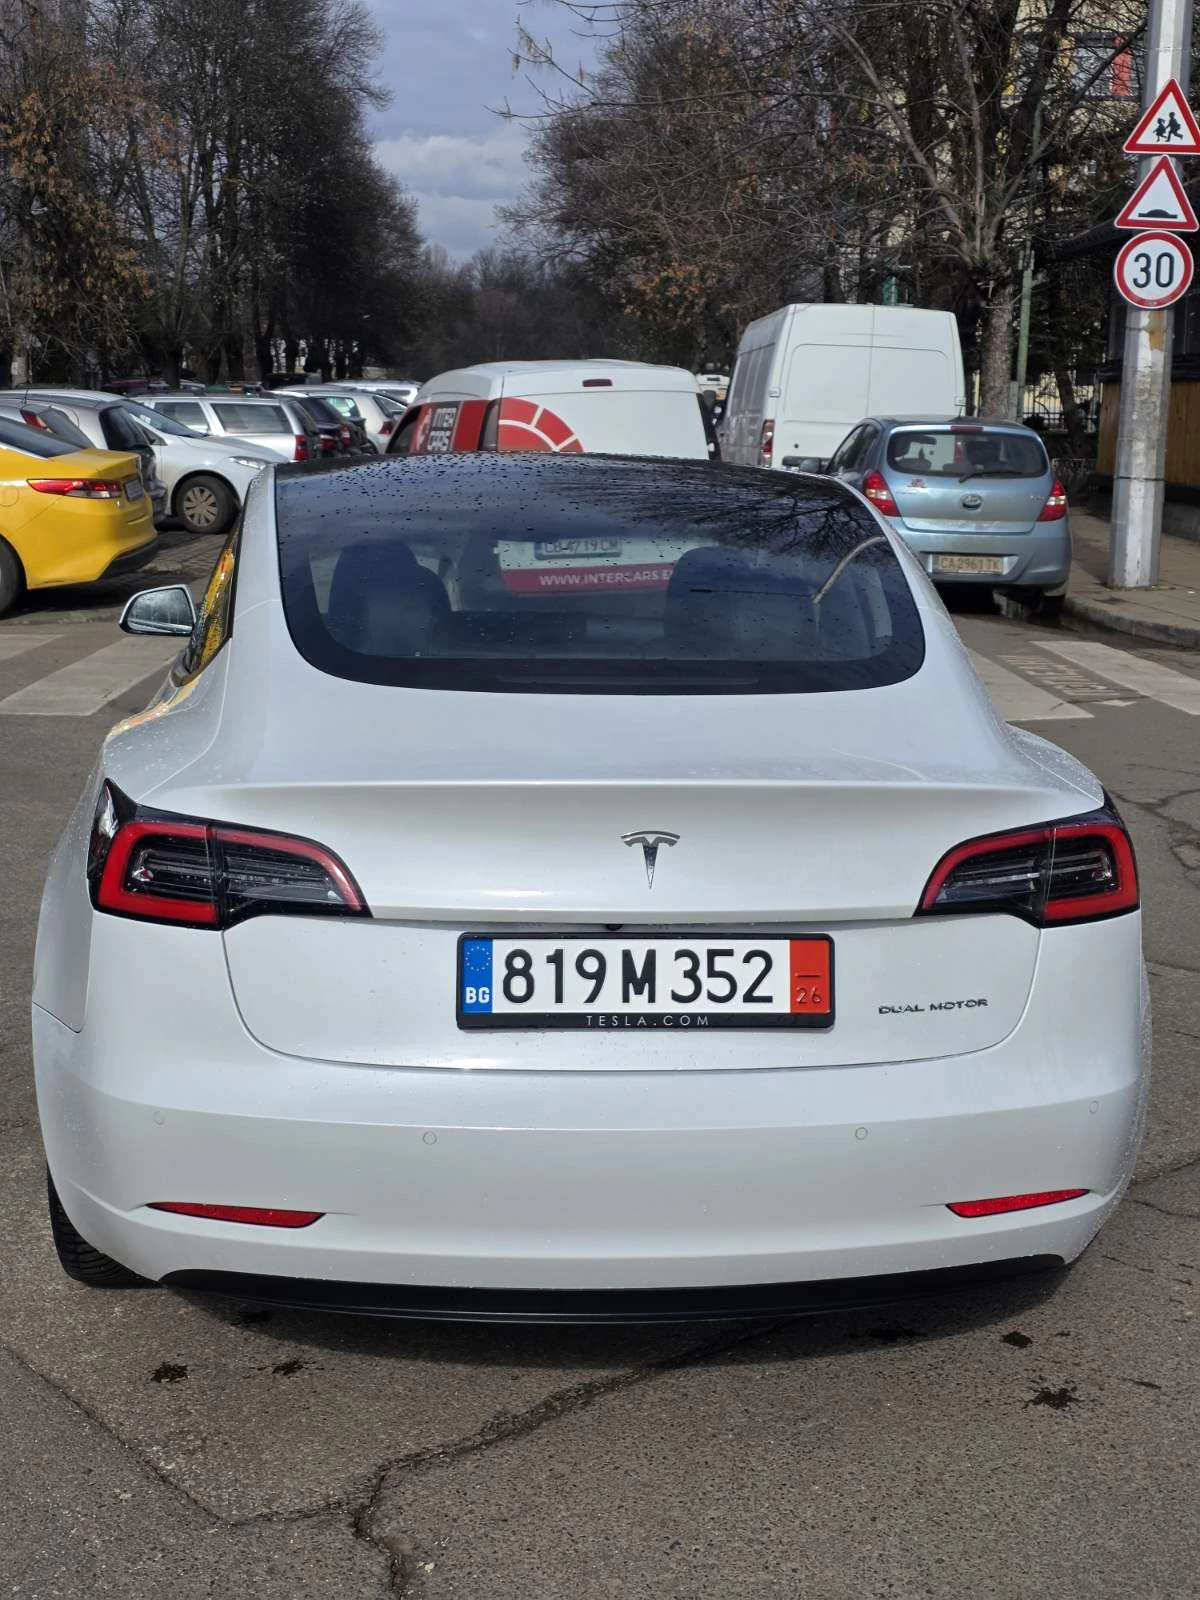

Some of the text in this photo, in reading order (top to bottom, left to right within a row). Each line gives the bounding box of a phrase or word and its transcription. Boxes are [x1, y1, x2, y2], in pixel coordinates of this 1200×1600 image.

[1132, 252, 1175, 288] 30
[465, 986, 490, 1004] BG
[796, 987, 822, 1004] 26
[878, 998, 989, 1015] DUAL MOTOR
[585, 1014, 710, 1027] TESLA.COM
